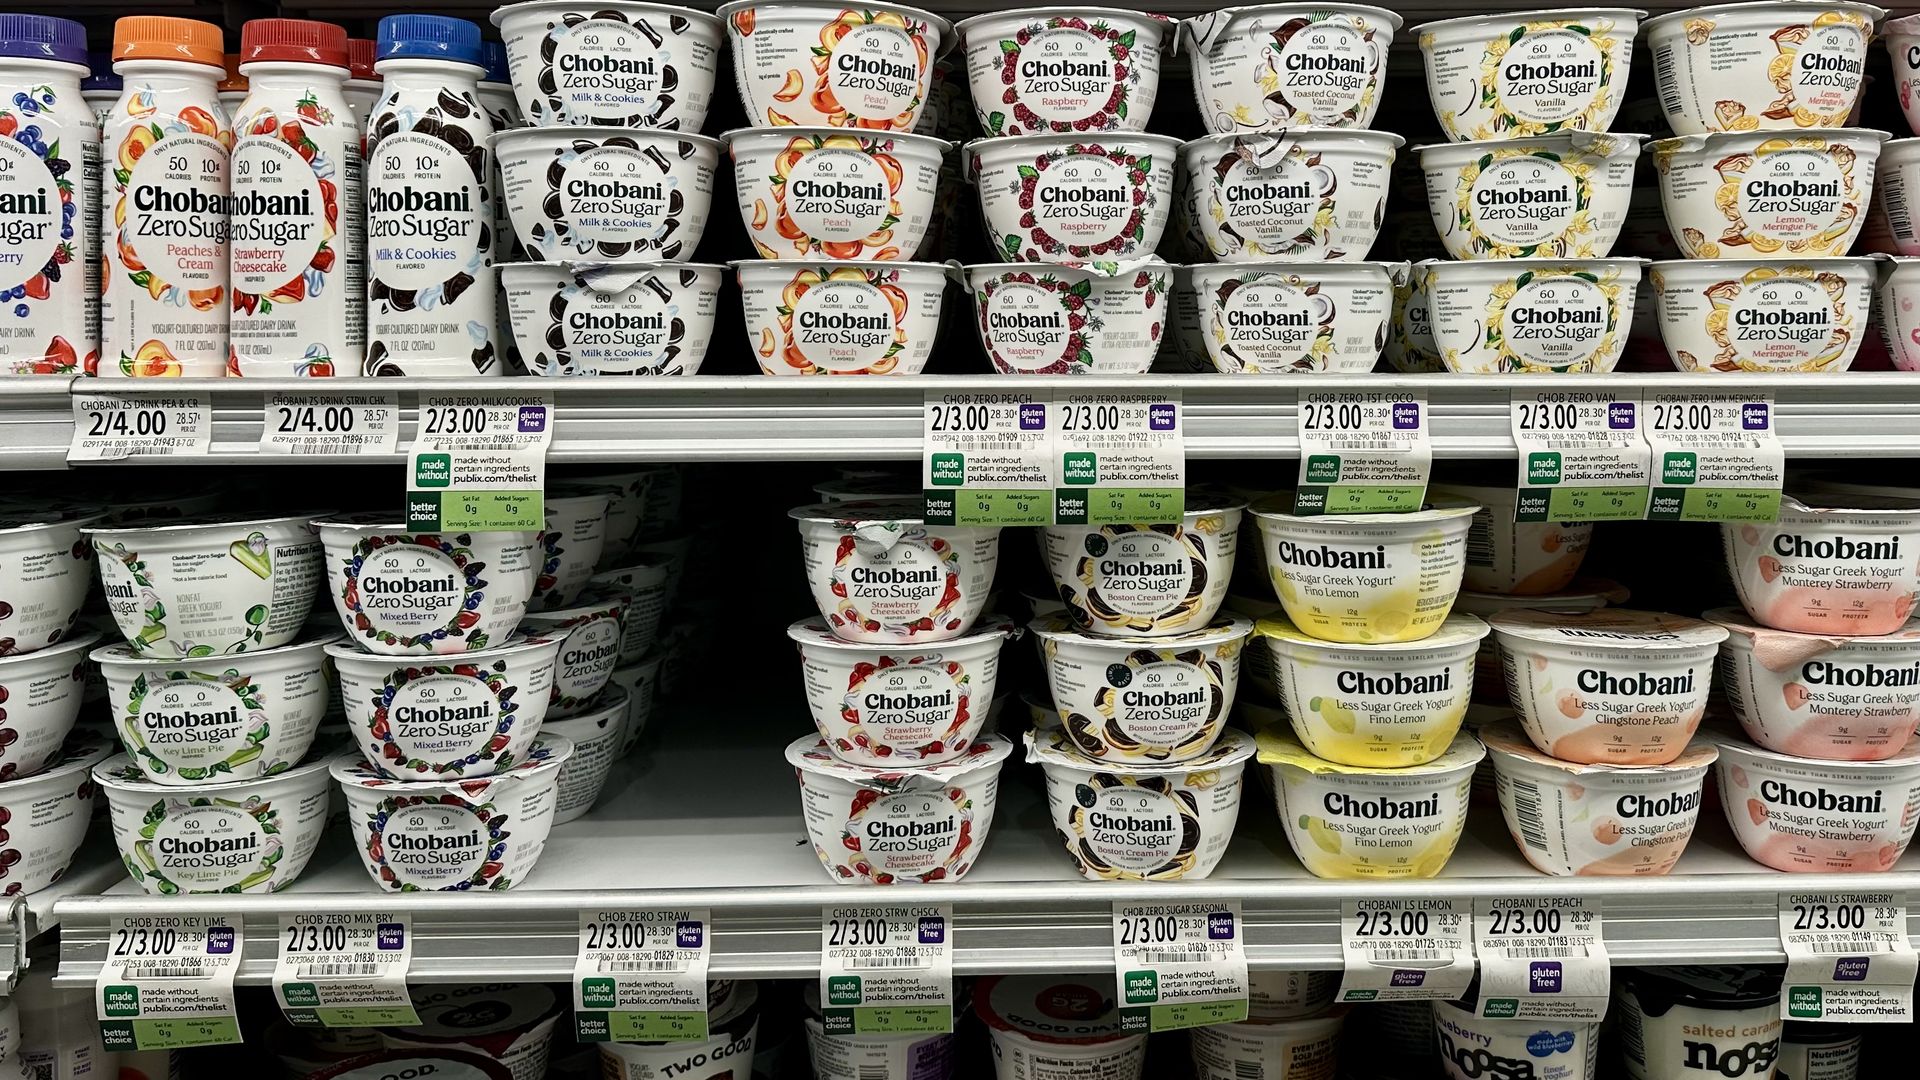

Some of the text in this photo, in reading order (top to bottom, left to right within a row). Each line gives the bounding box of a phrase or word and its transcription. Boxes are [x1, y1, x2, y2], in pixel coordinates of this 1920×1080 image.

[563, 74, 600, 88] Zero
[572, 93, 592, 101] Milk
[604, 94, 644, 103] Cookies
[1535, 98, 1566, 107] Vanilla
[386, 156, 401, 170] 50
[1043, 204, 1077, 218] Zero
[823, 217, 851, 227] Peach
[1236, 218, 1303, 228] Toasted Coconut
[1775, 215, 1806, 224] Lemon
[1060, 222, 1106, 233] Raspberry
[1255, 225, 1283, 234] Vanilla
[1762, 222, 1818, 234] Meringue Pie
[167, 244, 221, 257] Peaches &
[234, 248, 284, 262] Strawberry
[376, 249, 456, 260] Milk & Cookies
[178, 258, 214, 270] Cream
[273, 396, 386, 406] CHOBANI ZS DRINK STRW CHK
[429, 397, 542, 406] CHOB ZERO MILK/COOKIES
[944, 394, 1032, 404] CHOB ZERO PEACH
[1069, 395, 1167, 404] CHOB ZERO RASPBERRY
[1308, 393, 1413, 403] CHOB ZERO TST COCO
[1537, 393, 1616, 403] CHOB ZERO VAN
[1656, 394, 1765, 403] CHOBANI ZERO LMN MERINGUE
[81, 399, 198, 411] CHOBANI ZS DRINK PEA & CR
[278, 407, 354, 432] 2/4.00
[426, 408, 486, 433] 2/3.00
[521, 412, 544, 421] gluten
[932, 405, 988, 431] 2/3.00
[1062, 405, 1118, 430] 2/3.00
[1305, 404, 1361, 429] 2/3.00
[1519, 404, 1577, 429] 2/3.00
[1654, 405, 1711, 430] 2/3.00
[89, 411, 166, 436] 2/4.00
[422, 460, 445, 469] made
[418, 470, 448, 480] without
[454, 474, 537, 484] publix.com/thelist
[411, 502, 437, 511] better
[410, 512, 437, 520] choice
[277, 547, 308, 558] Nutrition
[1772, 563, 1793, 574] Less
[1796, 564, 1831, 578] Sugar
[1833, 565, 1866, 577] Greek
[1782, 577, 1892, 592] Monterey Strawberry
[1336, 699, 1359, 709] Less
[1361, 702, 1391, 713] Sugar
[1394, 701, 1423, 711] Greek
[1370, 715, 1425, 724] Fino Lemon
[1596, 714, 1679, 726] Clingstone Peach
[885, 726, 931, 736] Strawberry
[1128, 724, 1158, 732] Boston
[883, 732, 933, 741] Cheesecake
[413, 738, 473, 750] Mixed Berry
[163, 745, 225, 756] Key Lime Pie
[1492, 898, 1582, 908] CHOBANI LS PEACH
[1790, 894, 1893, 904] CHOBANI LS STRAWBERRY
[1122, 904, 1229, 917] CHOB ZERO SUGAR SEASONAL
[1358, 900, 1452, 910] CHOBANI LS LEMON
[599, 911, 690, 922] CHOB ZERO STRAW
[833, 907, 940, 918] CHOB ZERO STRW CHSCK
[1794, 905, 1865, 930] 2/3.00
[124, 917, 226, 928] CHOB ZERO KEY LIME
[295, 914, 394, 925] CHOB ZERO MIX BRY
[1356, 911, 1428, 936] 2/3.00
[1489, 909, 1561, 934] 2/3.00
[587, 923, 645, 949] 2/3.00
[829, 919, 887, 945] 2/3.00
[1120, 916, 1177, 945] 2/3.00
[114, 928, 175, 955] 2/3.00
[287, 926, 346, 952] 2/3.00
[1532, 968, 1560, 979] gluten
[1536, 977, 1554, 987] free
[1794, 992, 1816, 1001] made
[1790, 1000, 1820, 1011] without
[1683, 1025, 1735, 1037] salted
[661, 1054, 706, 1079] TWO
